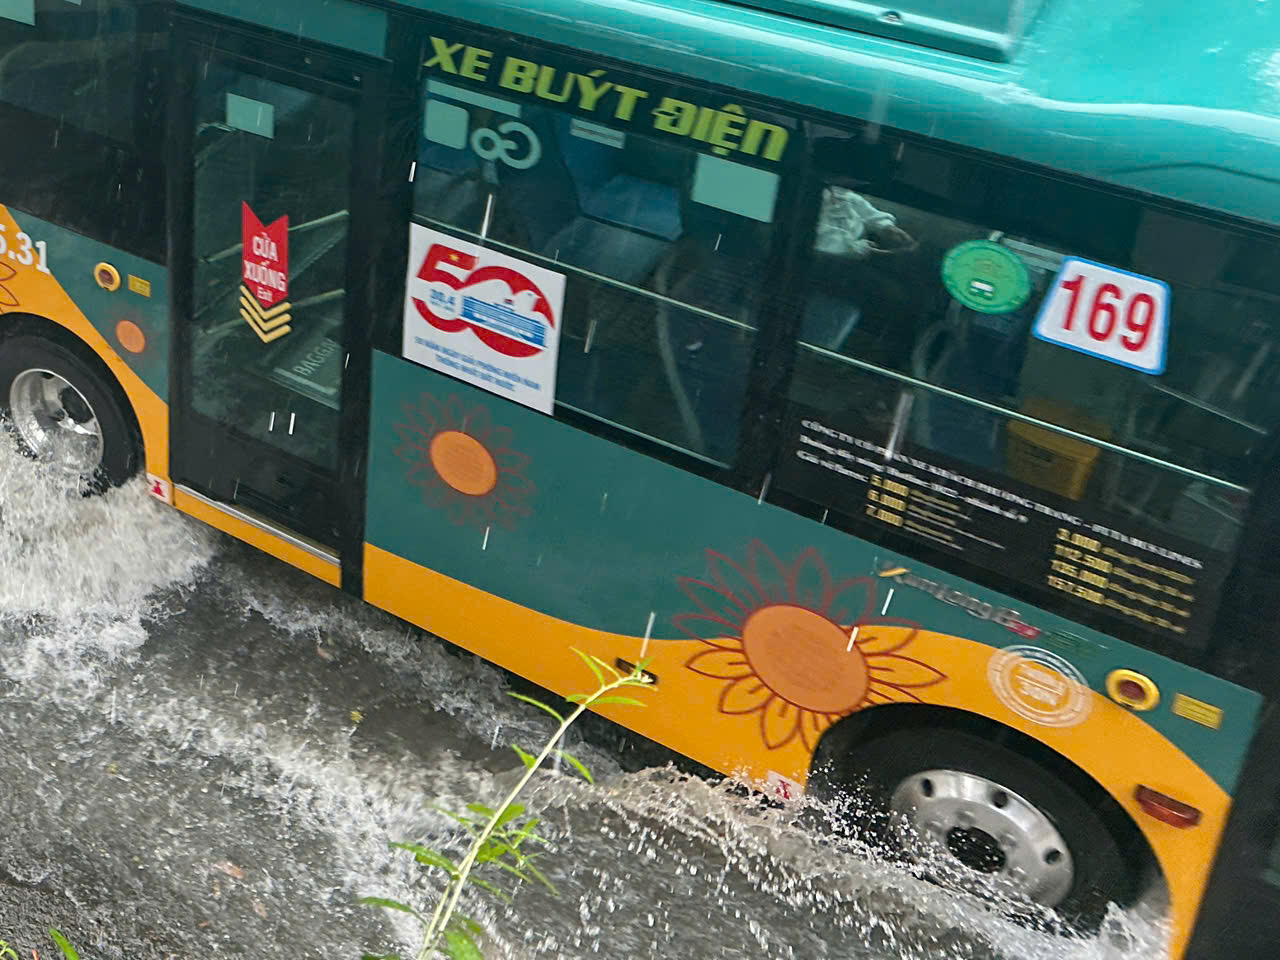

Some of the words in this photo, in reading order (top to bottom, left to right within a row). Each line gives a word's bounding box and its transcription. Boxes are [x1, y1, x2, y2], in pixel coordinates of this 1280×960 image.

[423, 36, 494, 83] XE
[498, 56, 649, 122] BUÝT
[252, 232, 279, 262] CỬA
[243, 260, 286, 292] XUỐNG
[1060, 274, 1157, 353] 169
